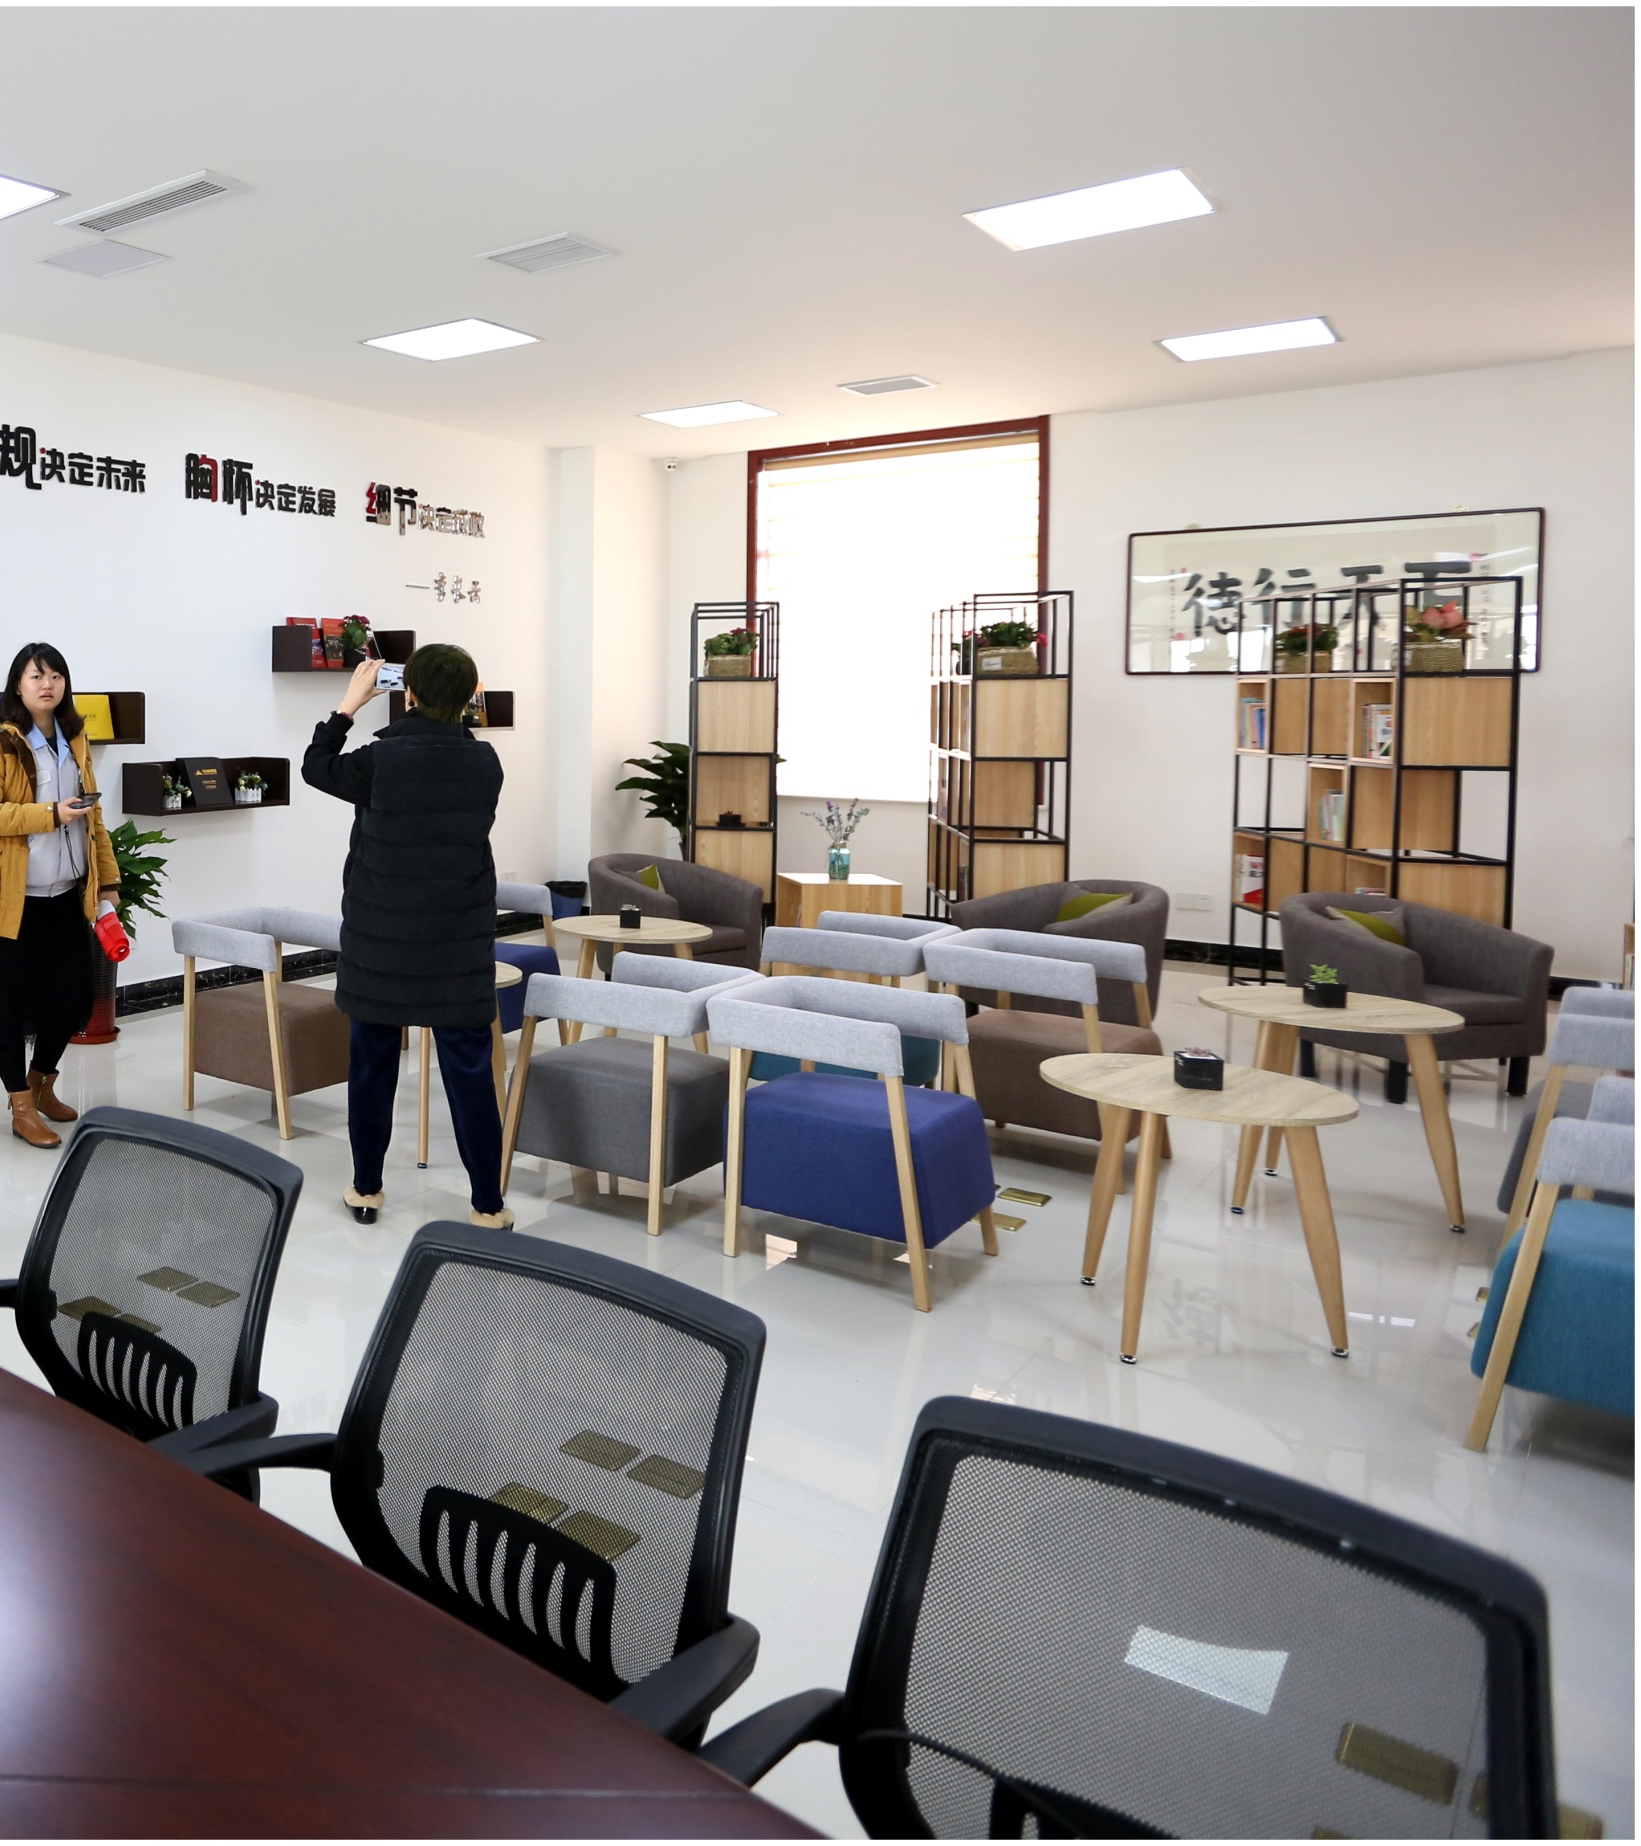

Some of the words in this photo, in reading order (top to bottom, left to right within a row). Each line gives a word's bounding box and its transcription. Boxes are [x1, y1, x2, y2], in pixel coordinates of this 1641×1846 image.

[185, 453, 336, 517] 胸怀决定发展
[365, 482, 486, 538] 细节决定成败
